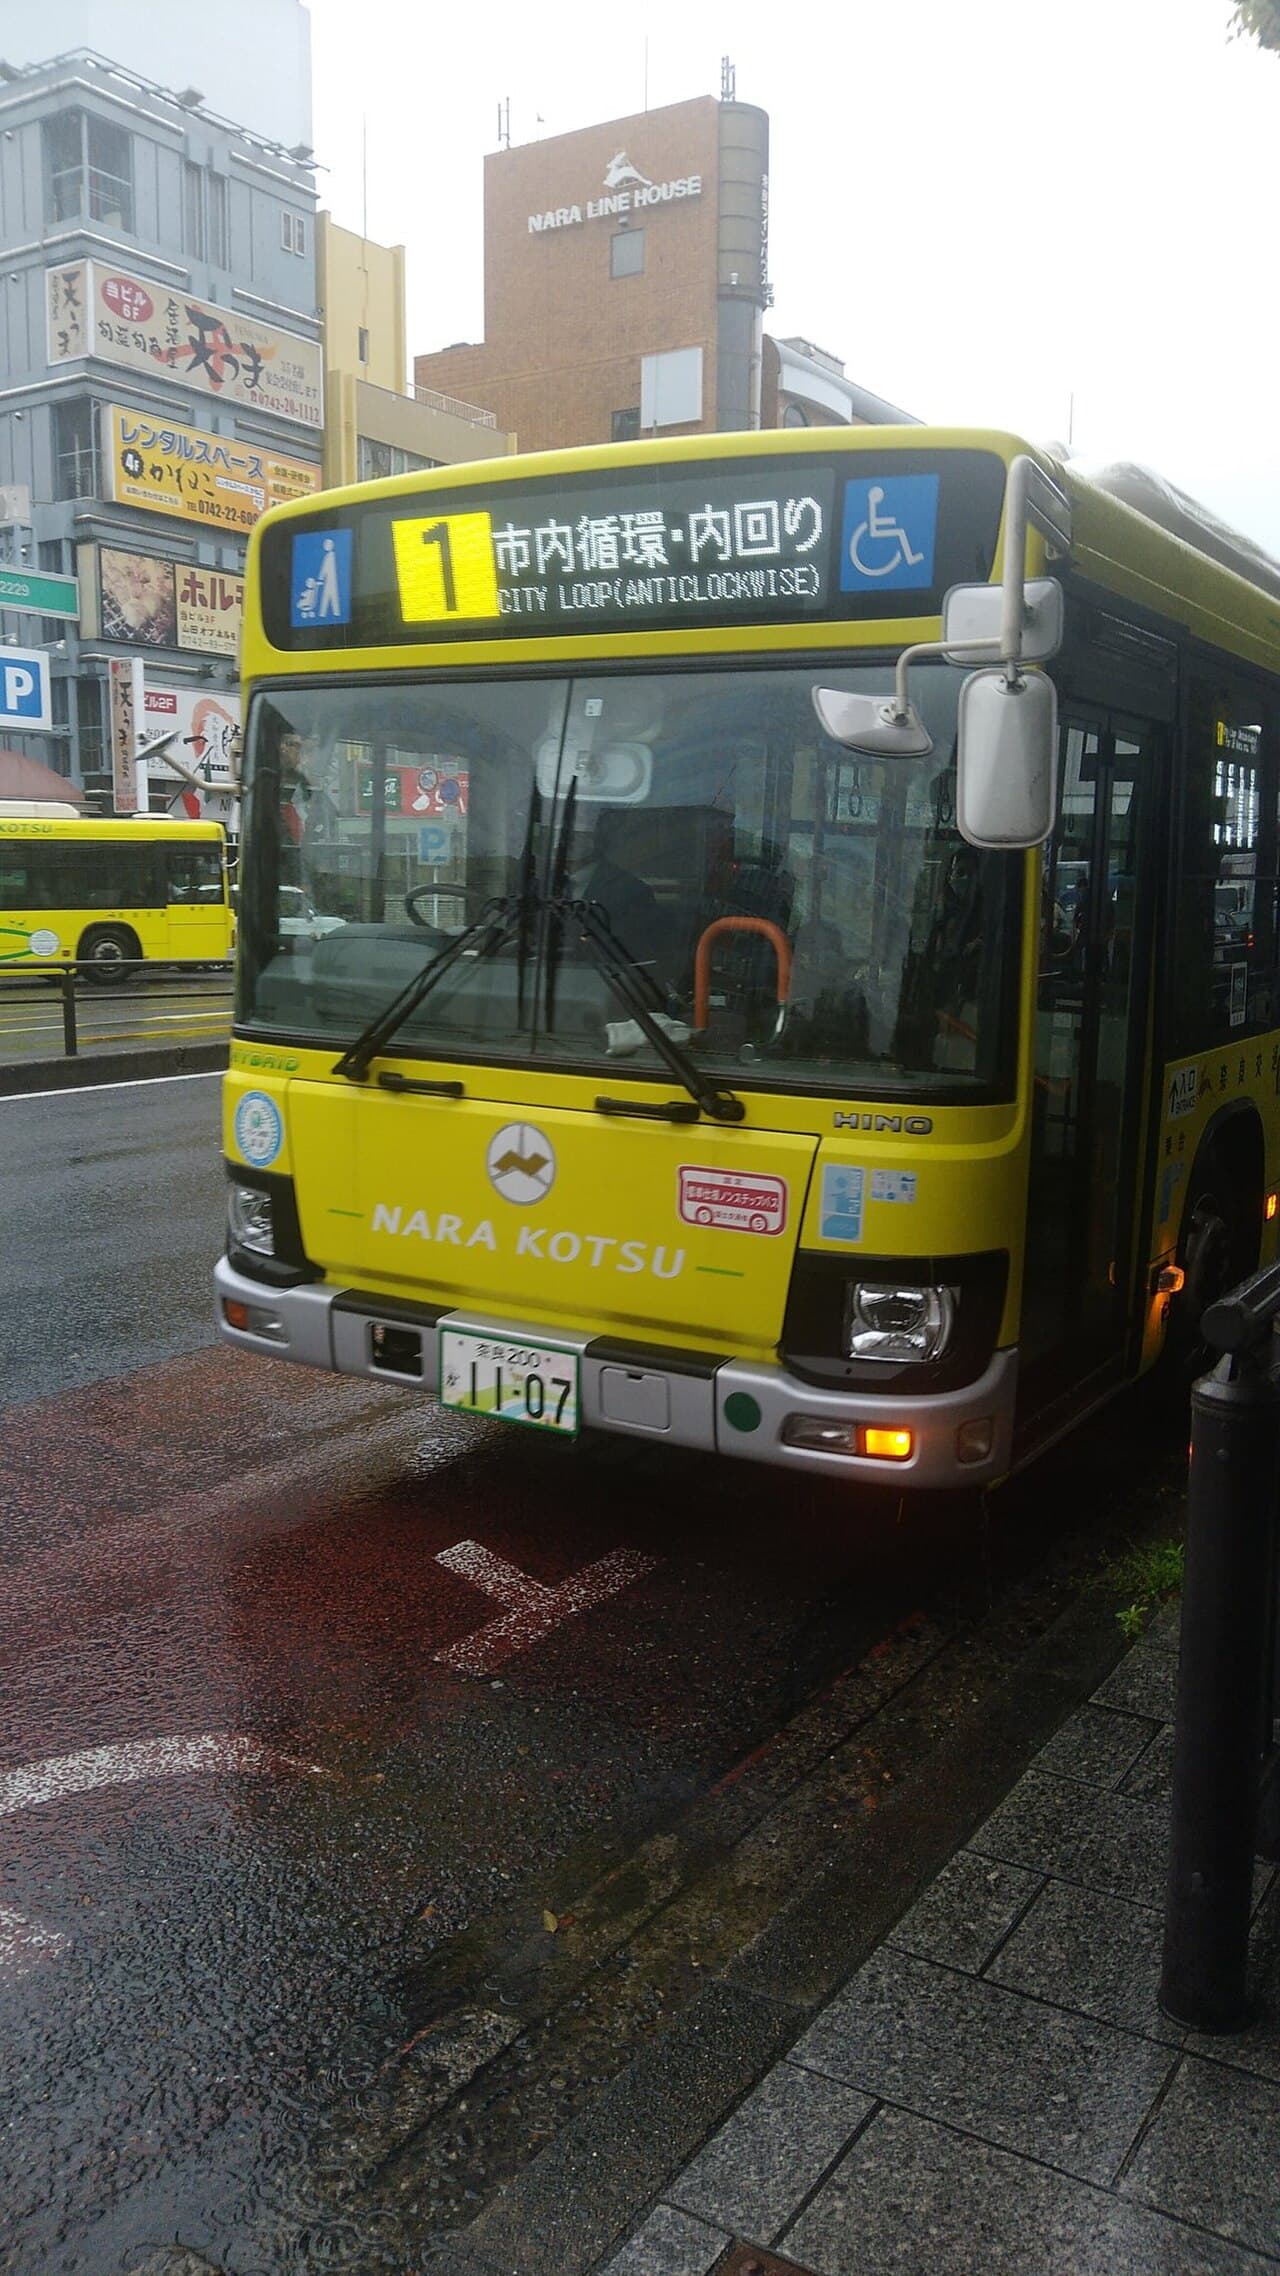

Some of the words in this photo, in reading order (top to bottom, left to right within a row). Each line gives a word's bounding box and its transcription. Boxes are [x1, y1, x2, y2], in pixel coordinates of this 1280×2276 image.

[528, 205, 583, 233] NARA
[587, 192, 630, 218] LINE
[634, 176, 702, 207] HOUSE
[106, 281, 147, 305] 当ビル
[122, 304, 140, 320] 6F
[120, 416, 265, 479] レンタルスペース
[125, 453, 140, 472] 4F
[492, 496, 823, 577] 市内循環・内回り
[421, 521, 458, 612] 1
[497, 586, 547, 614] CITY
[5, 667, 34, 711] P
[418, 826, 450, 862] P
[833, 1111, 933, 1136] HINO
[371, 1203, 497, 1252] NARA
[515, 1226, 685, 1280] KOTSU
